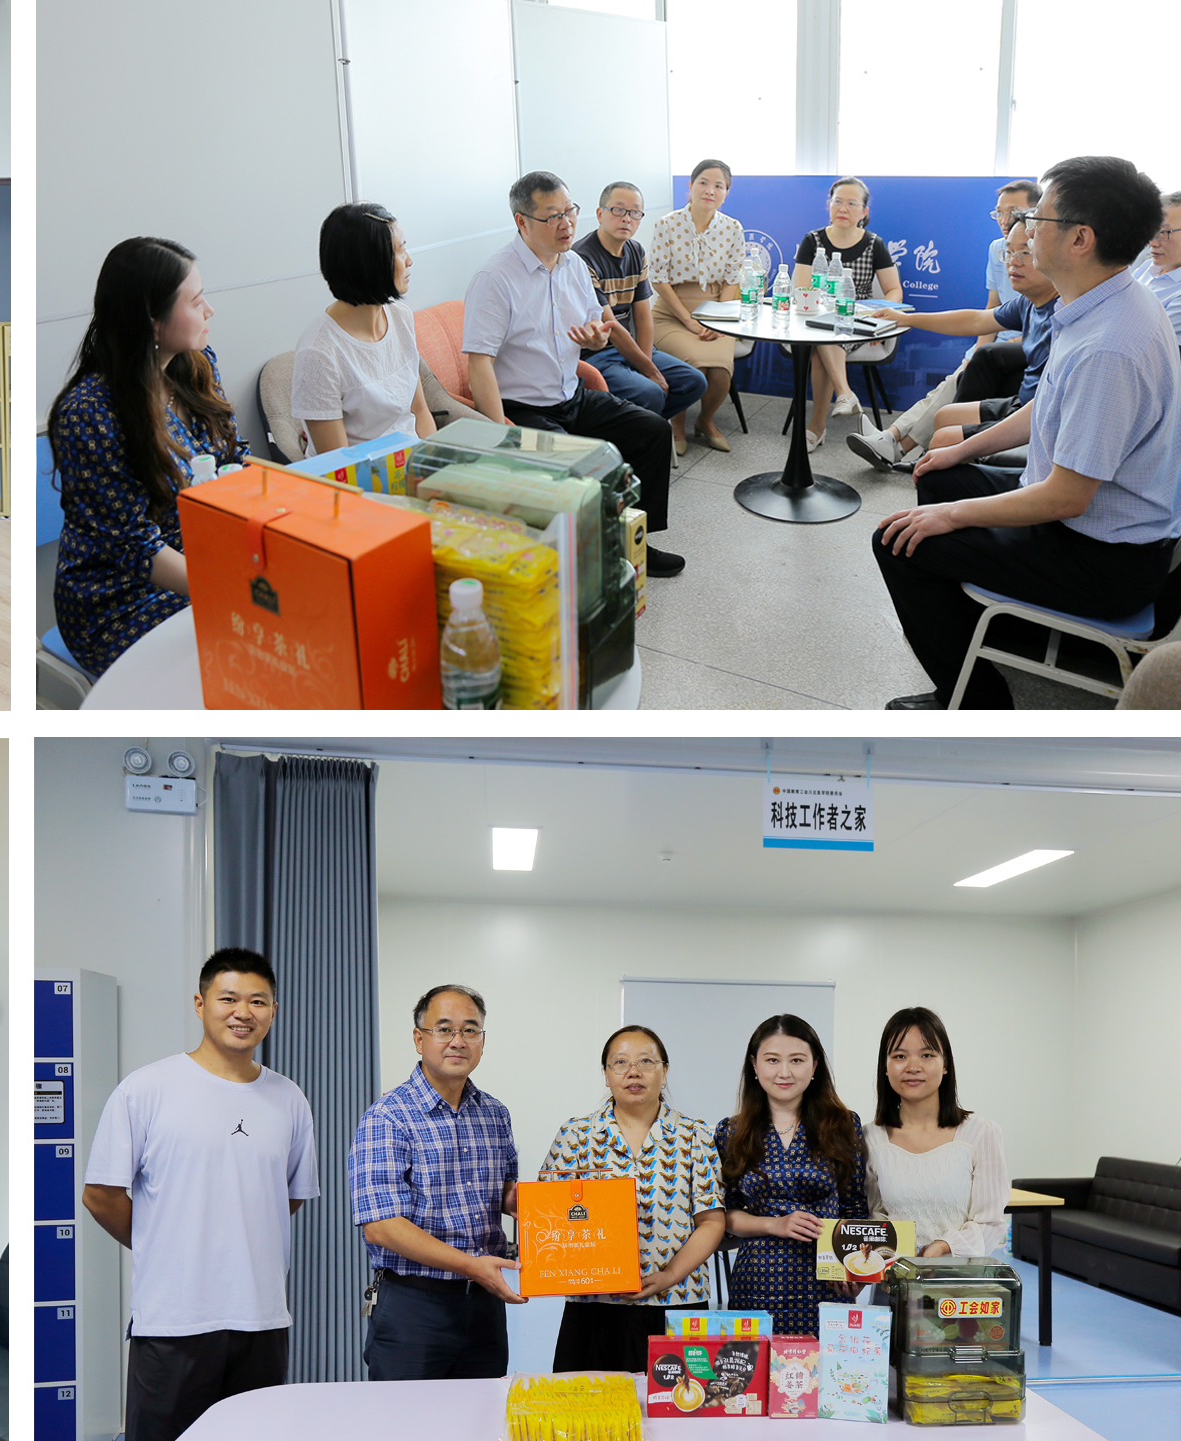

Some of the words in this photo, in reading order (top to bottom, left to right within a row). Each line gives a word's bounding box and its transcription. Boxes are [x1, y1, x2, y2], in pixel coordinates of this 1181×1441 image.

[902, 279, 939, 291] College
[770, 800, 867, 832] 科技工作者之家
[57, 983, 70, 993] 07
[57, 1065, 70, 1075] 08
[58, 1147, 71, 1157] 09
[58, 1228, 71, 1238] 10
[539, 1270, 556, 1278] FEN
[559, 1268, 588, 1277] XIANG
[591, 1267, 611, 1276] CHA
[613, 1266, 621, 1275] LI
[580, 1277, 590, 1285] 60
[958, 1300, 1001, 1316] 工会如家
[59, 1309, 71, 1318] 11
[838, 1333, 871, 1344] 金银花
[826, 1344, 882, 1356] 菊花枸杞茶
[785, 1371, 804, 1380] 红糖
[785, 1380, 804, 1389] 姜茶
[60, 1390, 72, 1399] 12
